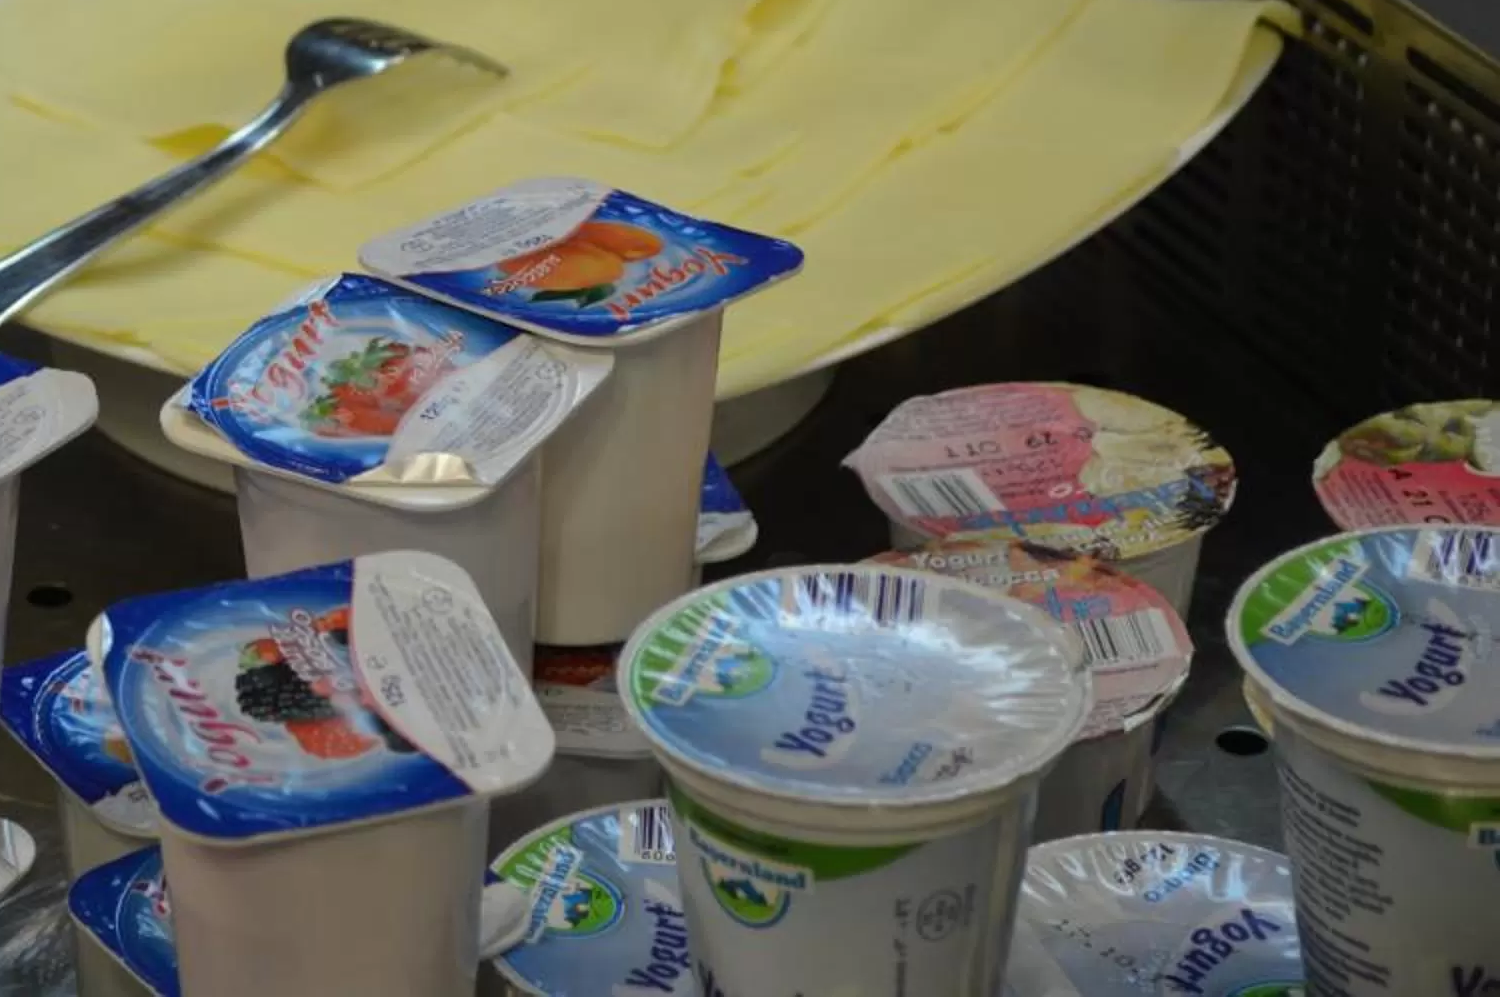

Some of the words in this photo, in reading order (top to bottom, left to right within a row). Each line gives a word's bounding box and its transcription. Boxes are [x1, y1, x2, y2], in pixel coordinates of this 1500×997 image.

[610, 245, 749, 321] Yogurt
[1272, 558, 1361, 641] Bayernland
[1380, 619, 1467, 707] Yogurt
[775, 663, 856, 759] Yogurt
[624, 900, 692, 993] Yogurt
[1162, 908, 1282, 996] Yogurt
